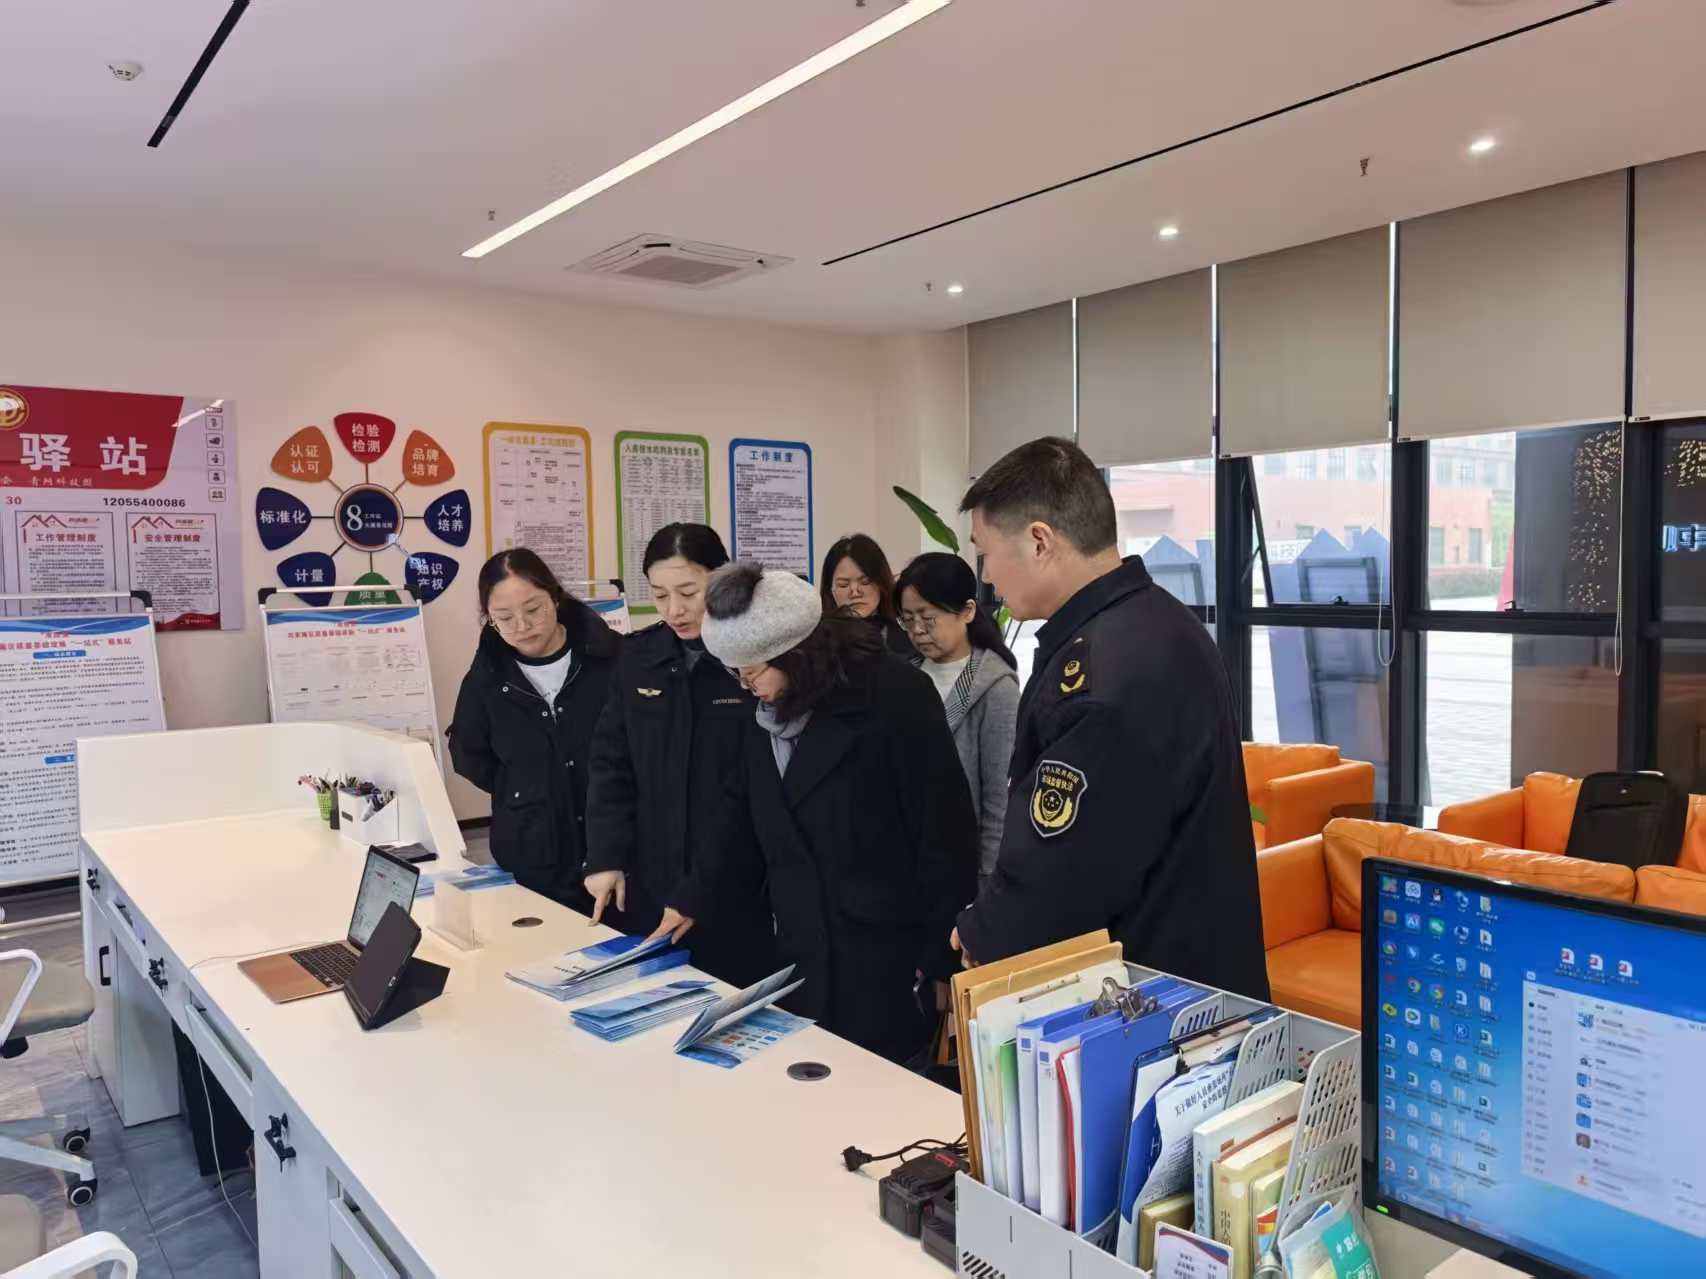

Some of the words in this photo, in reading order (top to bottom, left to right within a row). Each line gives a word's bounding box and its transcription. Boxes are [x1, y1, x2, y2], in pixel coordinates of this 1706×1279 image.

[351, 423, 381, 438] 检验
[290, 444, 320, 458] 认证
[351, 438, 381, 453] 检测
[19, 432, 148, 476] 驿站
[412, 448, 440, 462] 品牌
[290, 460, 320, 475] 认可
[412, 463, 440, 477] 培育
[103, 497, 186, 508] 12055400086
[260, 509, 308, 525] 标准化
[437, 503, 464, 517] 人才
[346, 504, 363, 531] 8
[437, 518, 464, 532] 培养
[294, 568, 324, 583] 计量
[416, 577, 444, 590] 产权
